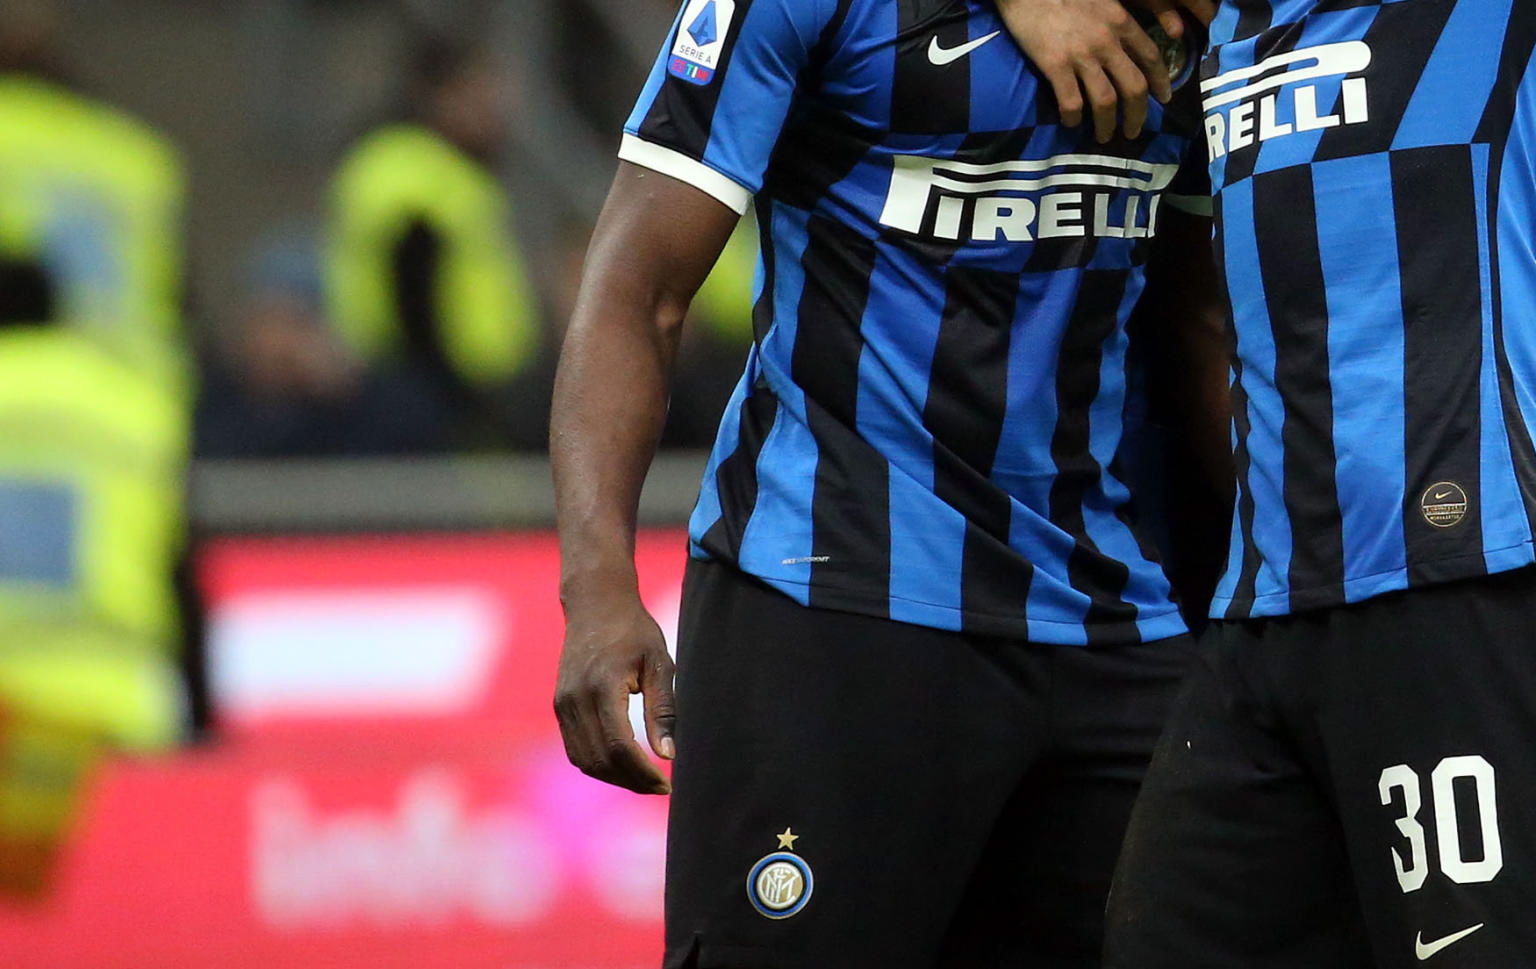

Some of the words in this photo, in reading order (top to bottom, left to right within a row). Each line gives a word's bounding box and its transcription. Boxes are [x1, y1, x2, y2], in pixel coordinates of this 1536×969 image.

[680, 44, 704, 60] SERIE
[879, 154, 1180, 242] PIRELLI
[1378, 755, 1503, 893] 30
